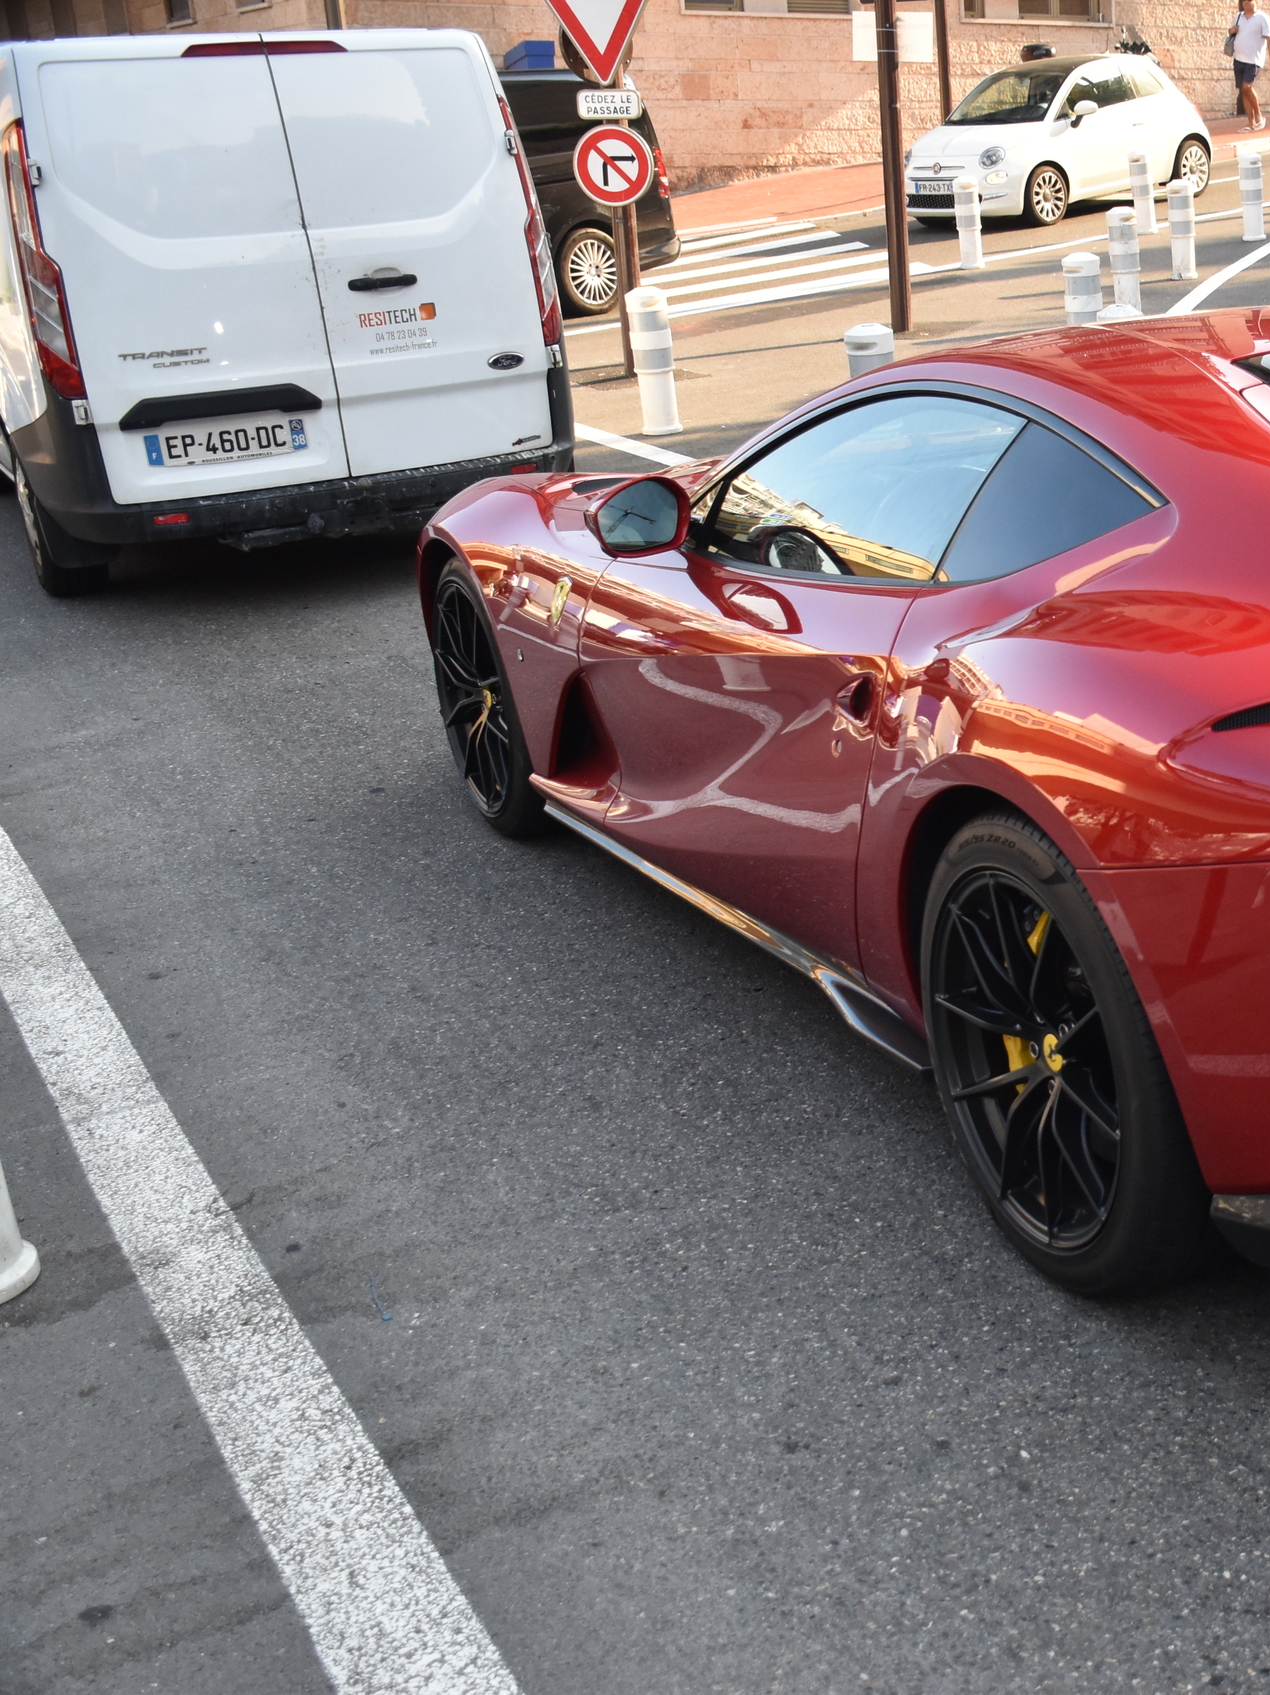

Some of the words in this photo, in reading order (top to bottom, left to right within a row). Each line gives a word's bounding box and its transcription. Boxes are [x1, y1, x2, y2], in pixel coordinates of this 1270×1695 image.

[584, 93, 616, 104] CÉDEZ
[620, 94, 632, 104] LE
[586, 106, 632, 115] PASSAGE
[358, 308, 418, 328] RESITECH
[375, 333, 385, 343] 04
[386, 331, 396, 342] 78
[397, 330, 407, 340] 23
[408, 328, 418, 338] 04
[418, 327, 428, 337] 39
[117, 347, 208, 361] TRANSIT
[369, 339, 438, 356] www.resitech-france.fr
[152, 358, 211, 369] CUSTOM
[164, 424, 287, 460] EP-460-DC
[292, 434, 307, 447] 38
[151, 452, 158, 460] F
[237, 451, 273, 459] AUTOMOBILES
